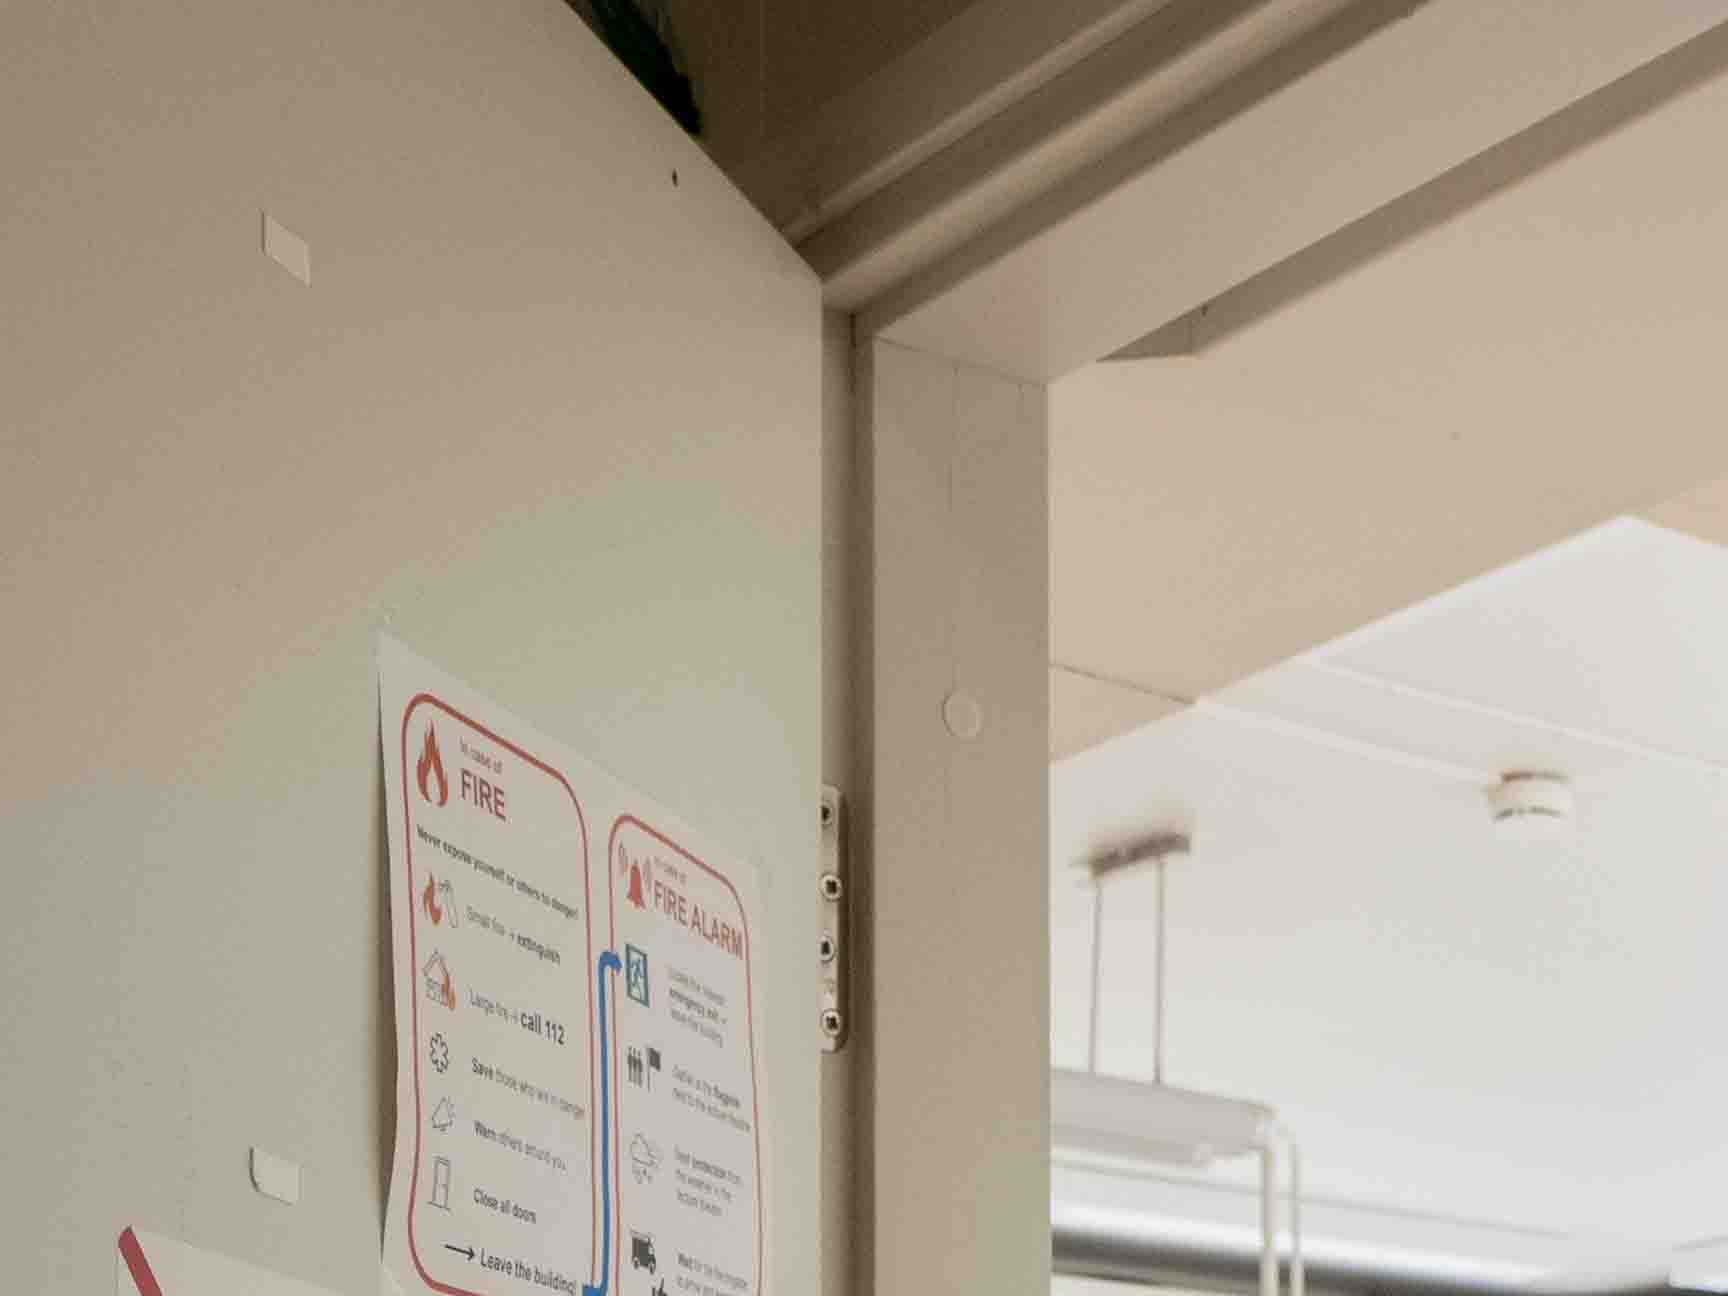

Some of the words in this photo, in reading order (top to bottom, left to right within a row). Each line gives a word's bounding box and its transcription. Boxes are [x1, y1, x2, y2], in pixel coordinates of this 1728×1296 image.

[461, 768, 507, 822] FIRE
[654, 880, 688, 927] FIRE
[690, 903, 744, 961] ALARM
[520, 1012, 542, 1034] call
[545, 1019, 565, 1046] 112
[471, 1056, 493, 1081] Save
[473, 1186, 499, 1211] Close
[499, 1199, 511, 1215] all
[512, 1204, 537, 1225] doors
[479, 1247, 513, 1276] Leave
[514, 1259, 532, 1282] the
